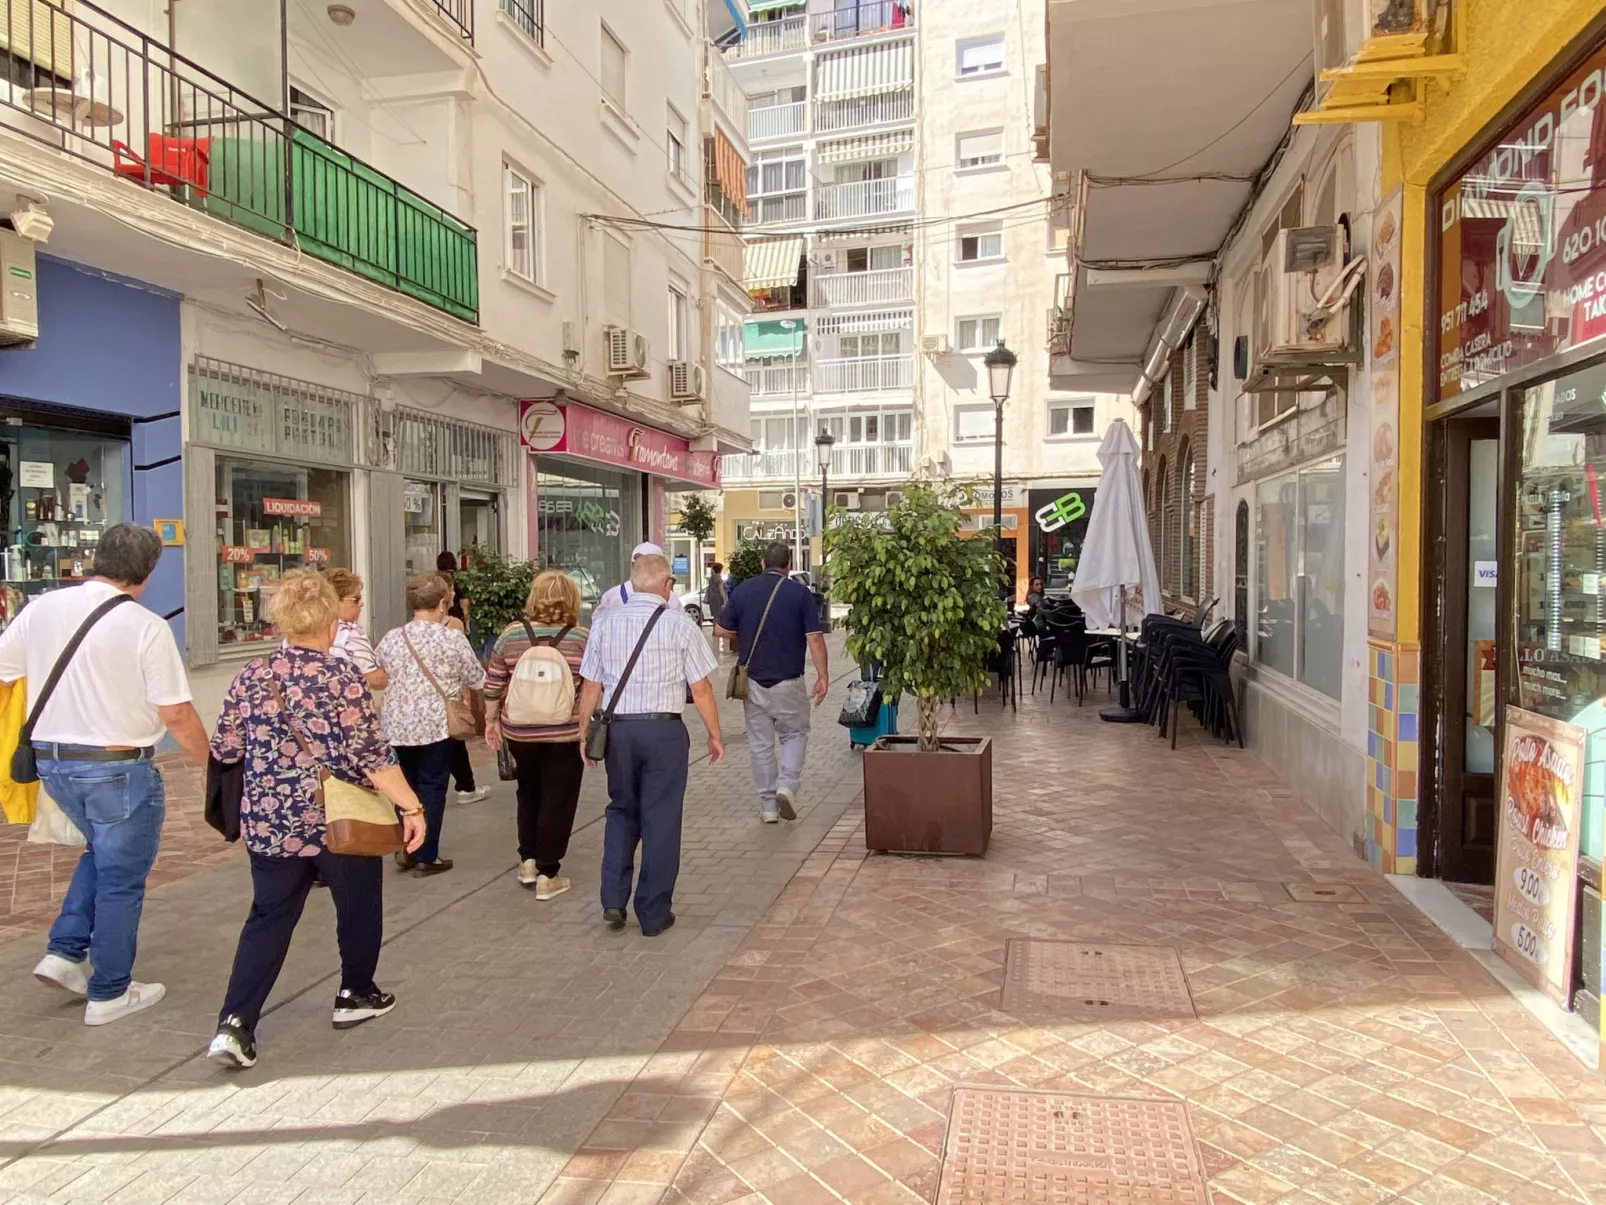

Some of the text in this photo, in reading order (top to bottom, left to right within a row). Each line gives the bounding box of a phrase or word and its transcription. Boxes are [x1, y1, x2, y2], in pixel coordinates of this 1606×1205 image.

[1442, 69, 1606, 232] DIAMOND FO
[1563, 226, 1592, 264] 620
[1563, 276, 1594, 308] HOME
[1441, 309, 1454, 335] 951
[266, 502, 321, 515] LIQUIDACIÓN
[227, 548, 250, 562] 20%
[308, 550, 328, 562] 50%
[1478, 570, 1497, 578] VIS
[1523, 664, 1545, 679] mucho
